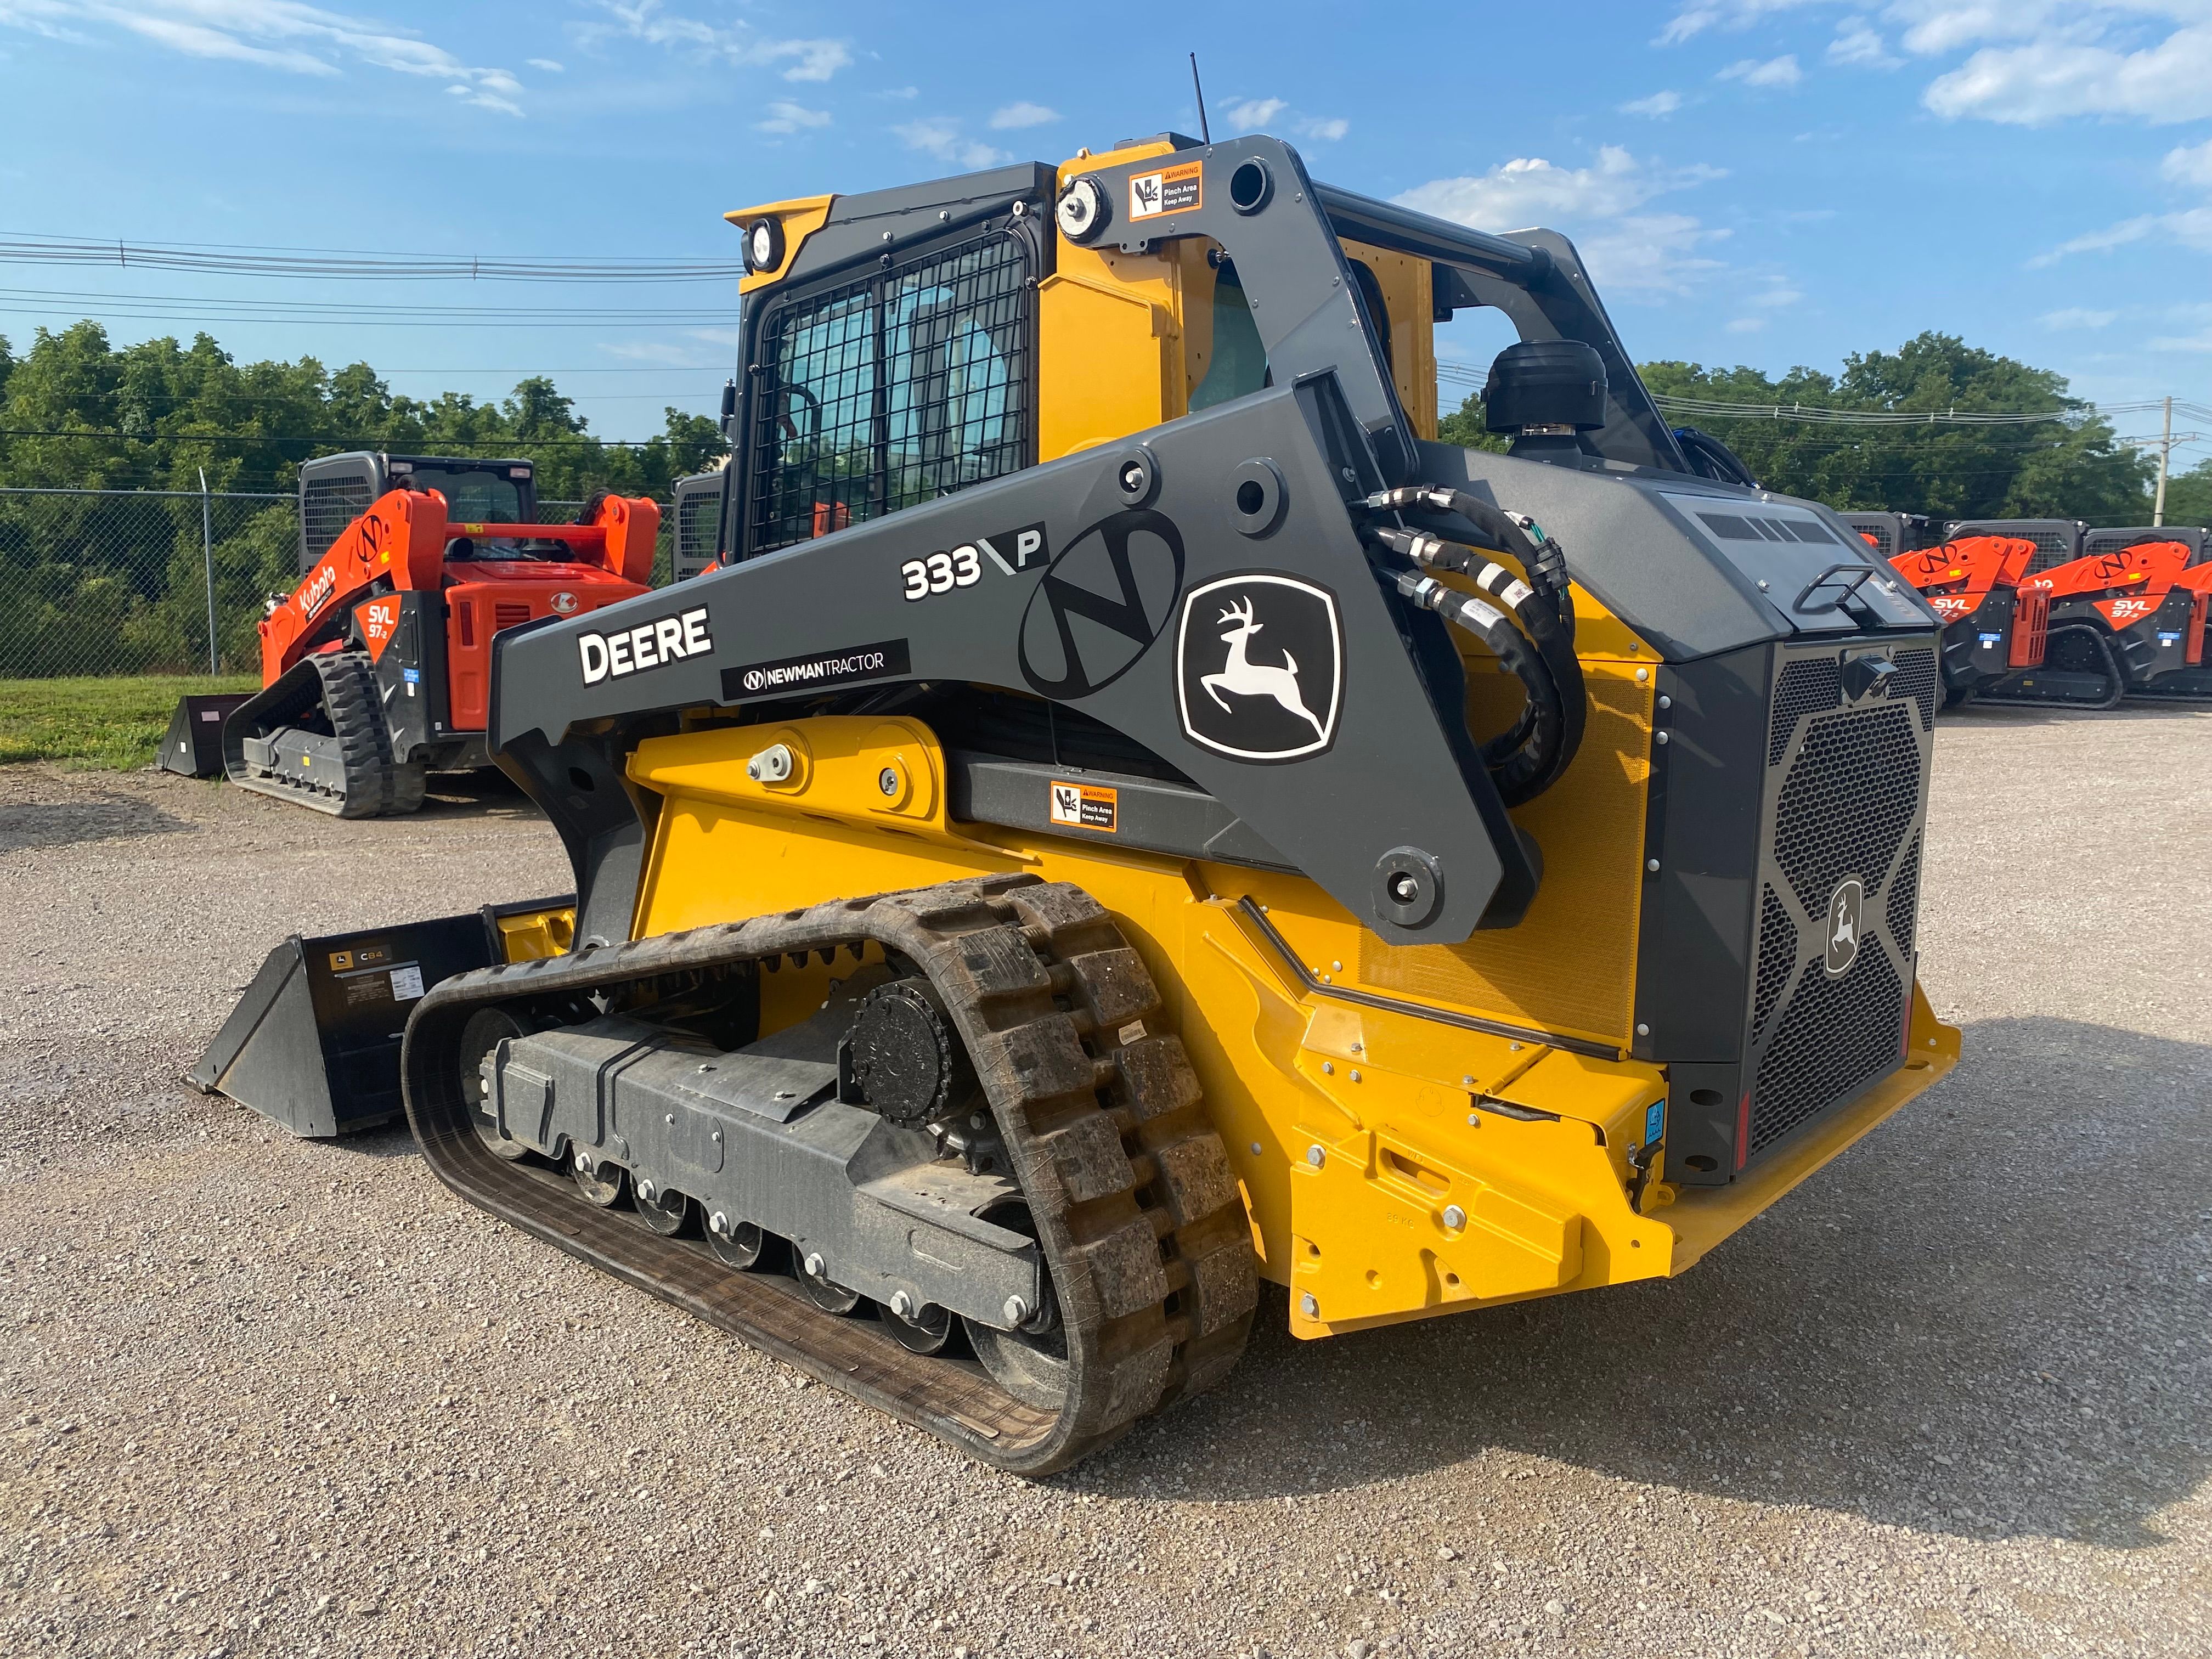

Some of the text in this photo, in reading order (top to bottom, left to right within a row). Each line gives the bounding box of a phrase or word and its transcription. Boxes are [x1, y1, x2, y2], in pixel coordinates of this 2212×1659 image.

[1170, 167, 1198, 177] WARNING
[1164, 187, 1181, 196] Pinch
[299, 566, 336, 612] Kubota
[1932, 599, 1971, 610] SVL
[2112, 600, 2151, 611] SVL
[368, 605, 394, 624] SVL
[369, 624, 387, 639] 97-2
[579, 608, 712, 684] DEERE
[1088, 791, 1113, 799] WARNING
[1082, 804, 1112, 815] Pinch Area
[1094, 815, 1108, 823] Away
[1402, 1217, 1414, 1229] KG
